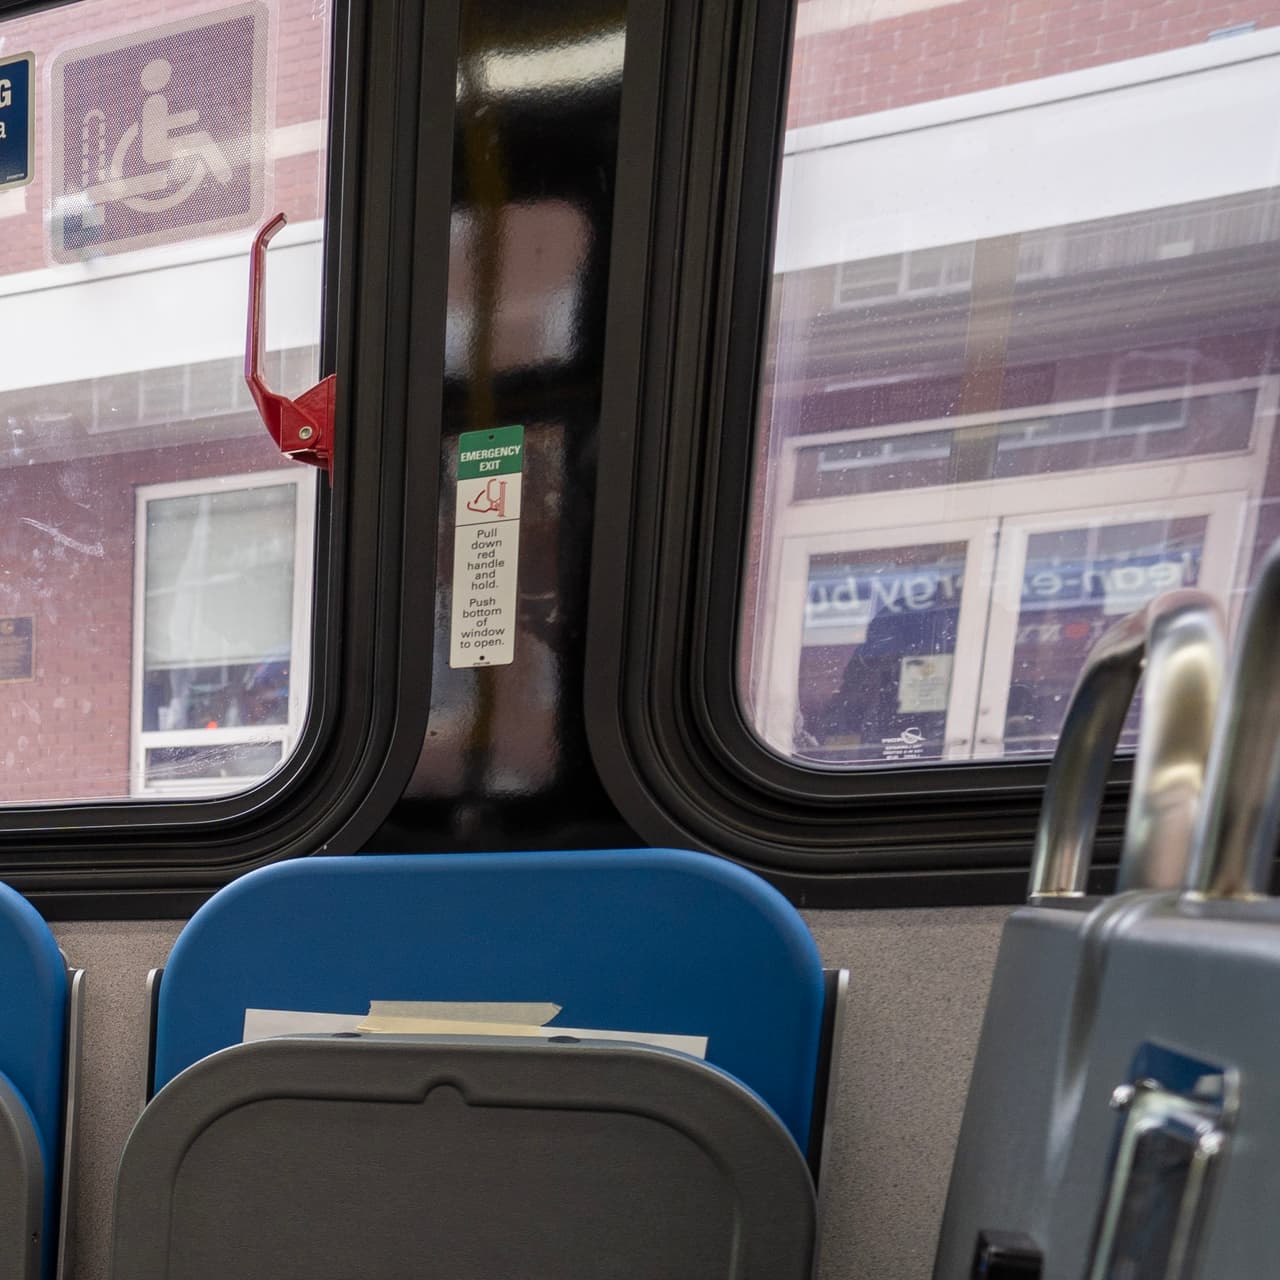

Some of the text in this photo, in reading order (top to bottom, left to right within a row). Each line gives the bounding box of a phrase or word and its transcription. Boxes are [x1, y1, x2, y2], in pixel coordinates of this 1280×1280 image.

[460, 444, 522, 463] EMERGENCY
[479, 459, 501, 472] EXIT
[477, 527, 497, 539] Pull
[471, 540, 502, 550] down
[477, 548, 495, 560] red
[467, 558, 505, 571] handle
[474, 569, 496, 581] and
[471, 579, 499, 591] hold.
[469, 596, 496, 608] Push
[462, 608, 502, 618] bottom
[476, 616, 488, 628] of
[460, 627, 506, 639] window
[460, 638, 505, 649] to open.
